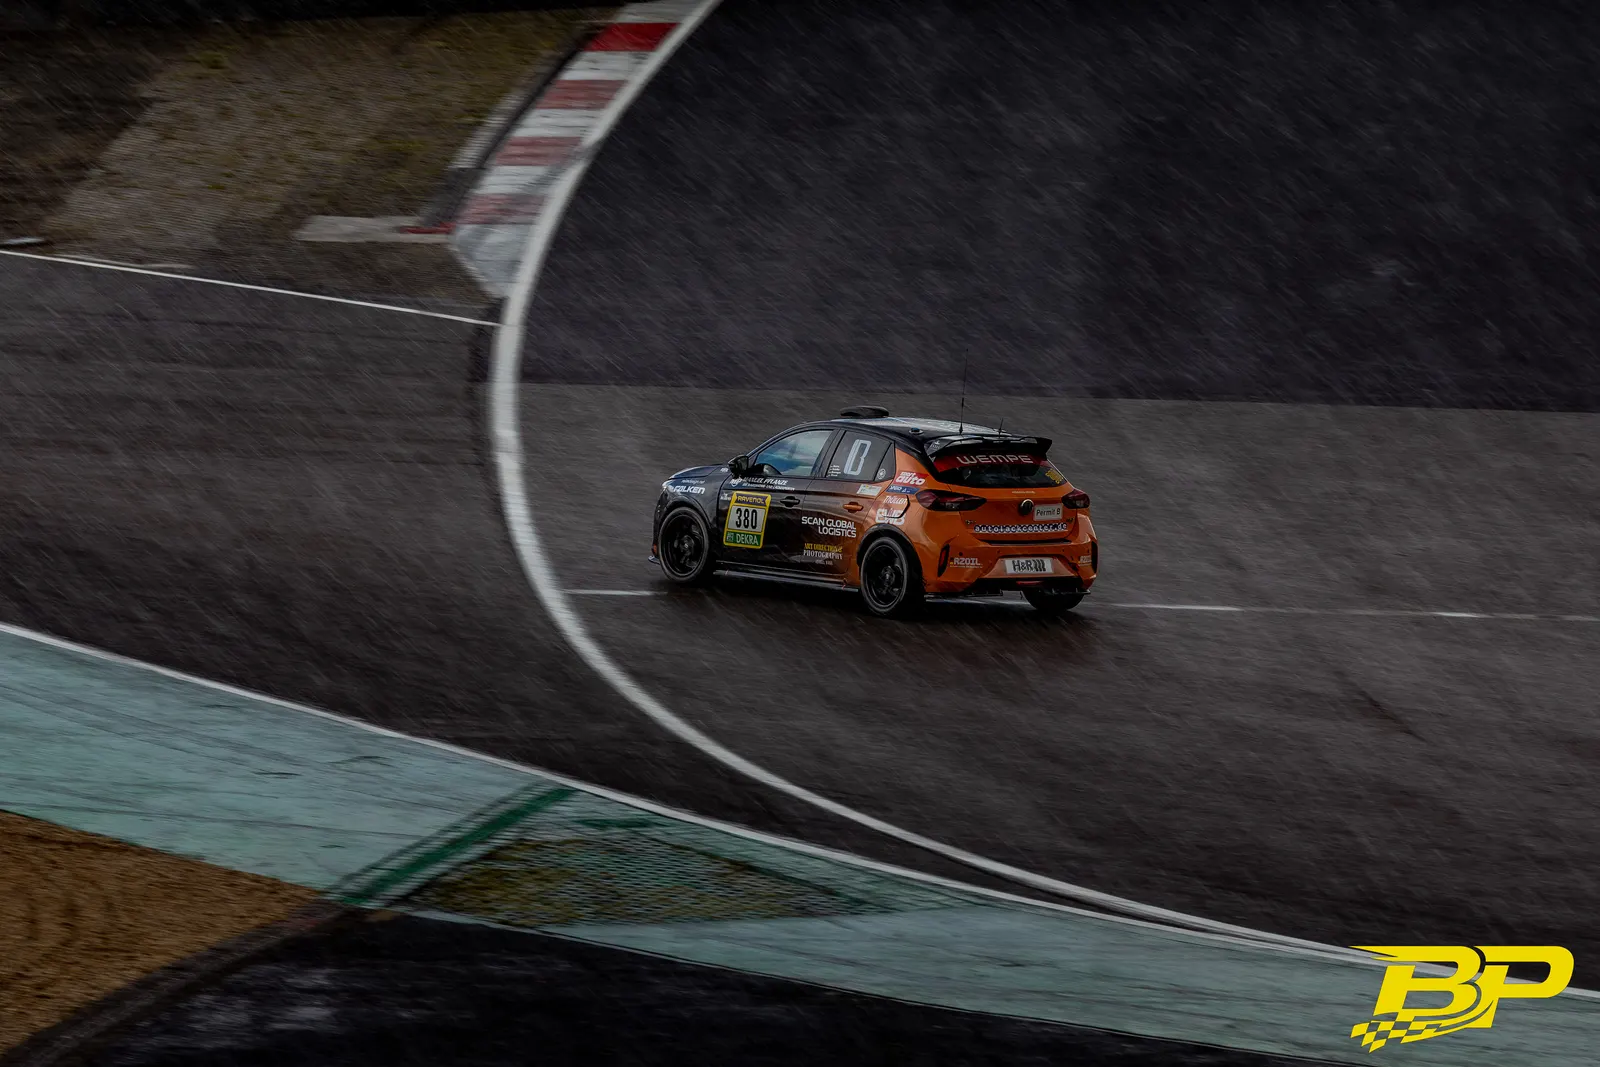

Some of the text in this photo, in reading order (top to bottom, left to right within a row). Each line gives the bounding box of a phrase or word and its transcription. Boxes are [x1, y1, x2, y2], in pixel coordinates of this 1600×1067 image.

[957, 454, 1034, 465] WEMPE
[895, 476, 926, 486] auto
[673, 485, 706, 495] FALKEN
[737, 496, 765, 504] RAVENOL
[1036, 508, 1056, 517] Permit
[736, 508, 758, 529] 380
[801, 516, 857, 530] SCAN GLOBAL
[818, 525, 857, 538] LOGISTICS
[974, 522, 1068, 533] autolackcenter.de
[736, 533, 759, 546] DEKRA
[803, 549, 843, 560] PHOTOGRAPHY
[1012, 559, 1033, 572] H&R
